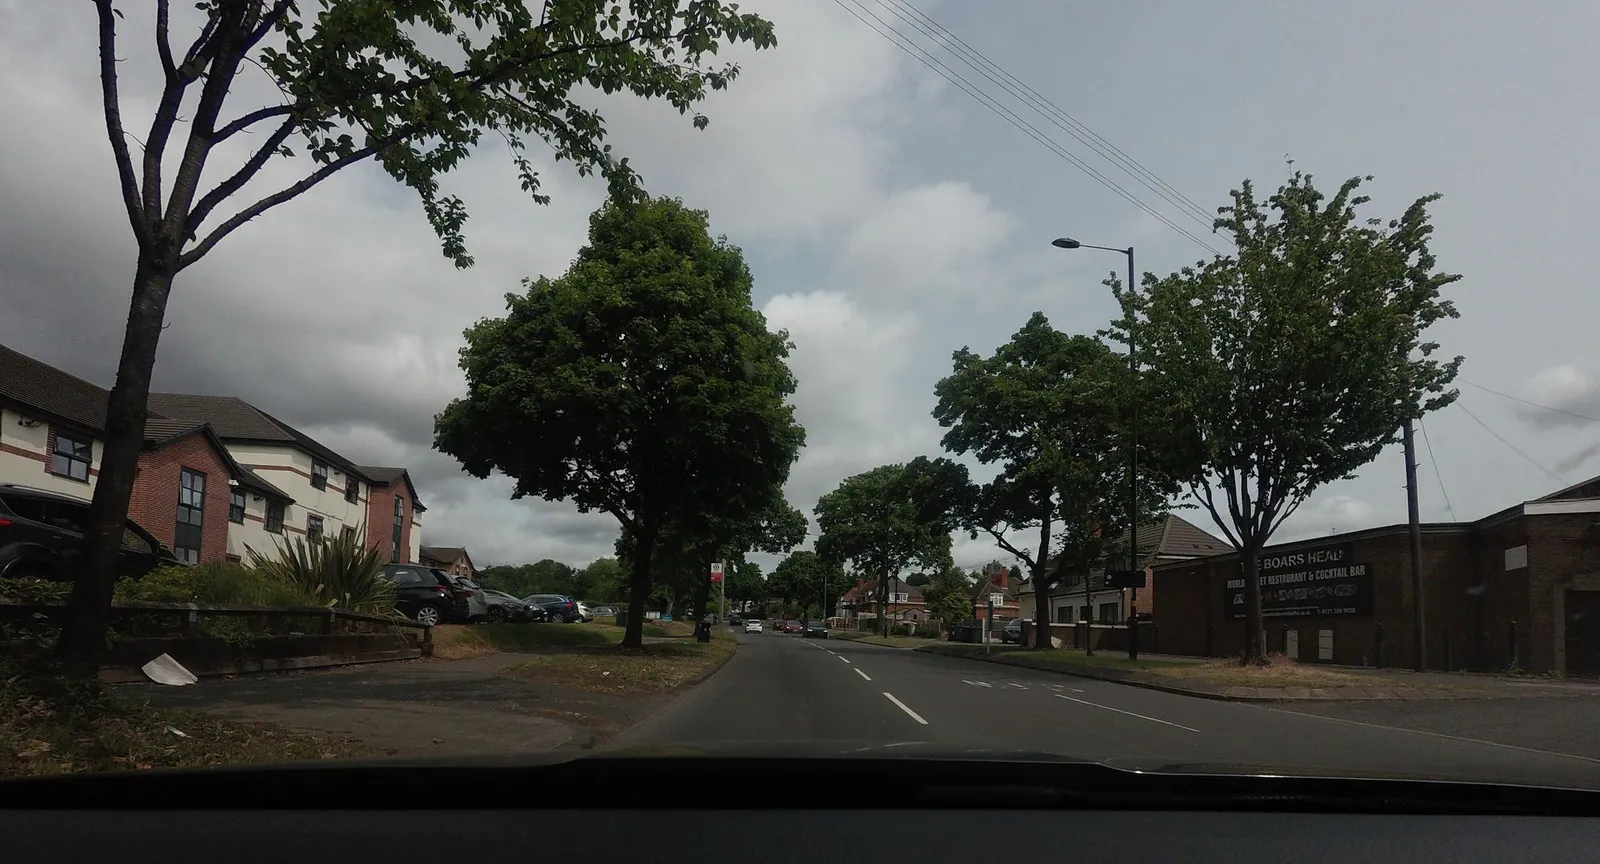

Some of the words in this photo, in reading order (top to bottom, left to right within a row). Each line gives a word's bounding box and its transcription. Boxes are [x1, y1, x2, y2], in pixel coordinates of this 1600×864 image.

[1240, 560, 1262, 572] TE
[1264, 554, 1304, 569] BOARS
[1227, 579, 1246, 589] WORLD
[1268, 571, 1307, 585] RESTAURANT
[1308, 571, 1314, 581] &
[1315, 568, 1348, 580] COCKTAIL
[1350, 565, 1365, 577] BAR
